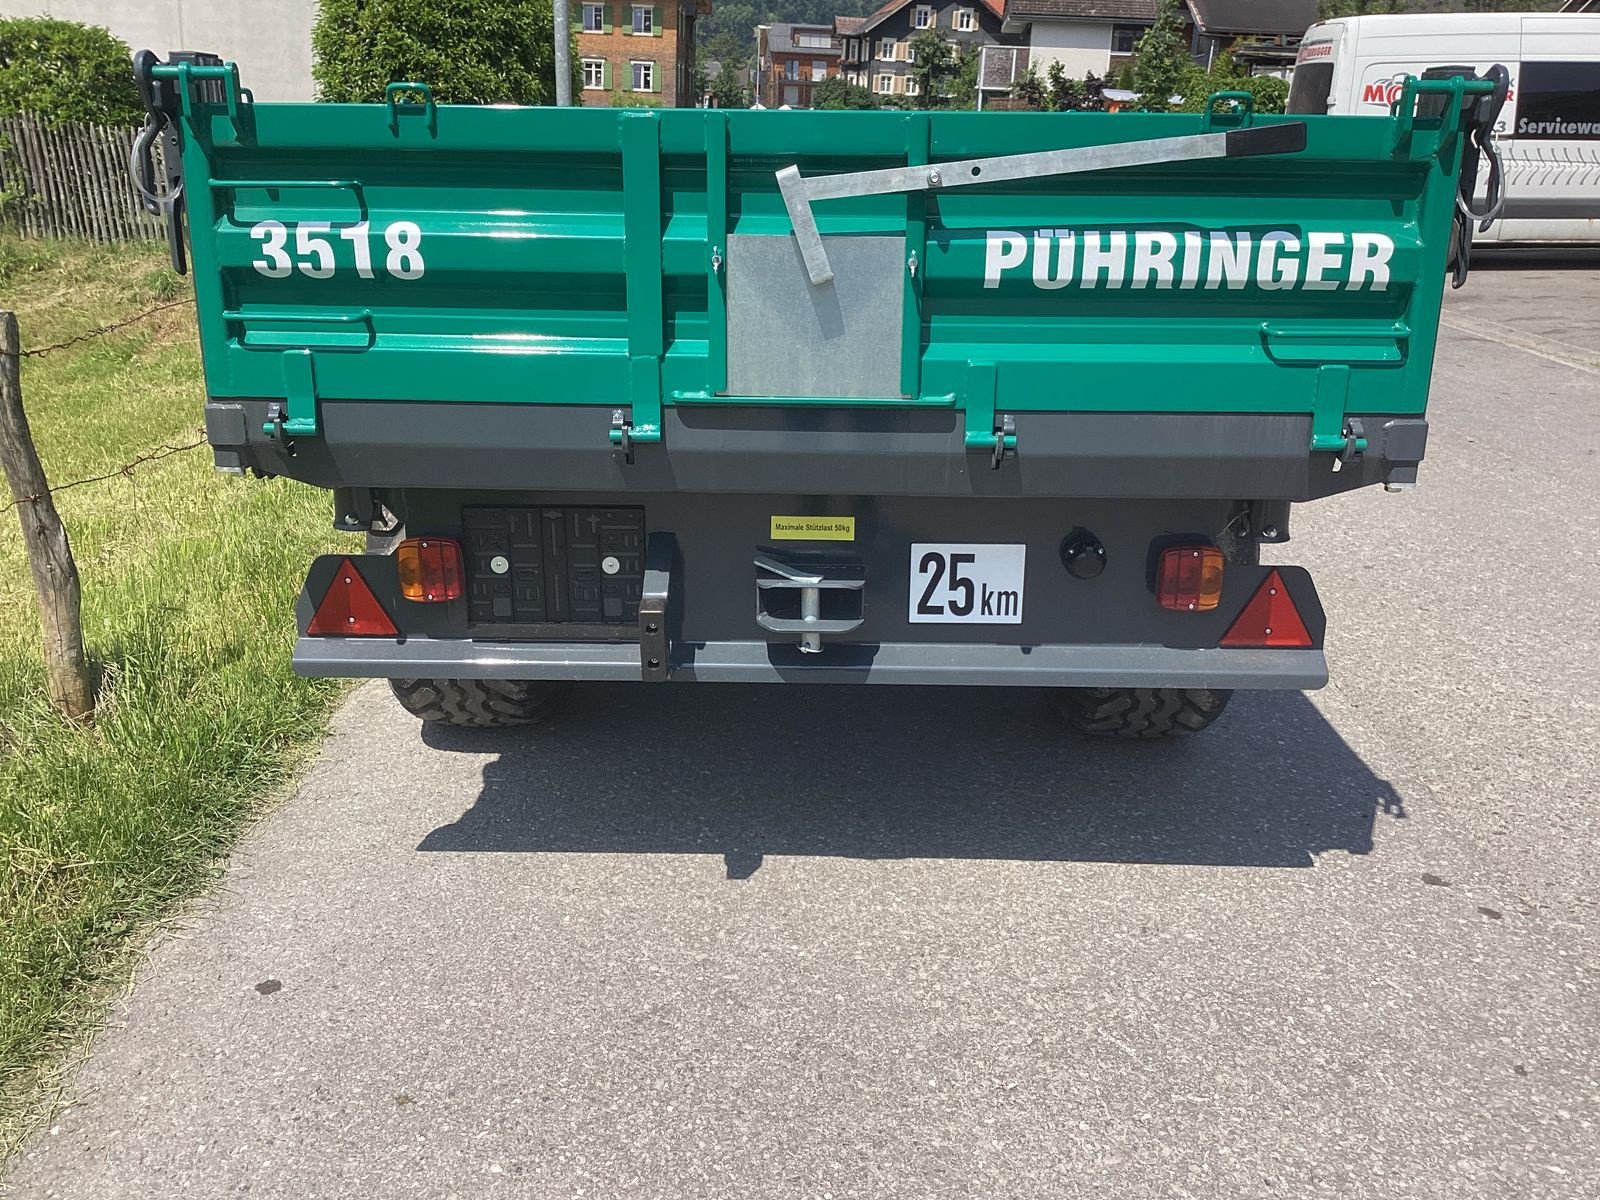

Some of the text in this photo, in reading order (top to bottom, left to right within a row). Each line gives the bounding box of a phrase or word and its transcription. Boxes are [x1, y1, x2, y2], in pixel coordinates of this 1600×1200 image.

[250, 220, 425, 281] 3518
[983, 228, 1396, 292] PÜHRINGER
[775, 523, 850, 533] Maximale Stützlast 50kg
[917, 551, 1019, 617] 25 km
